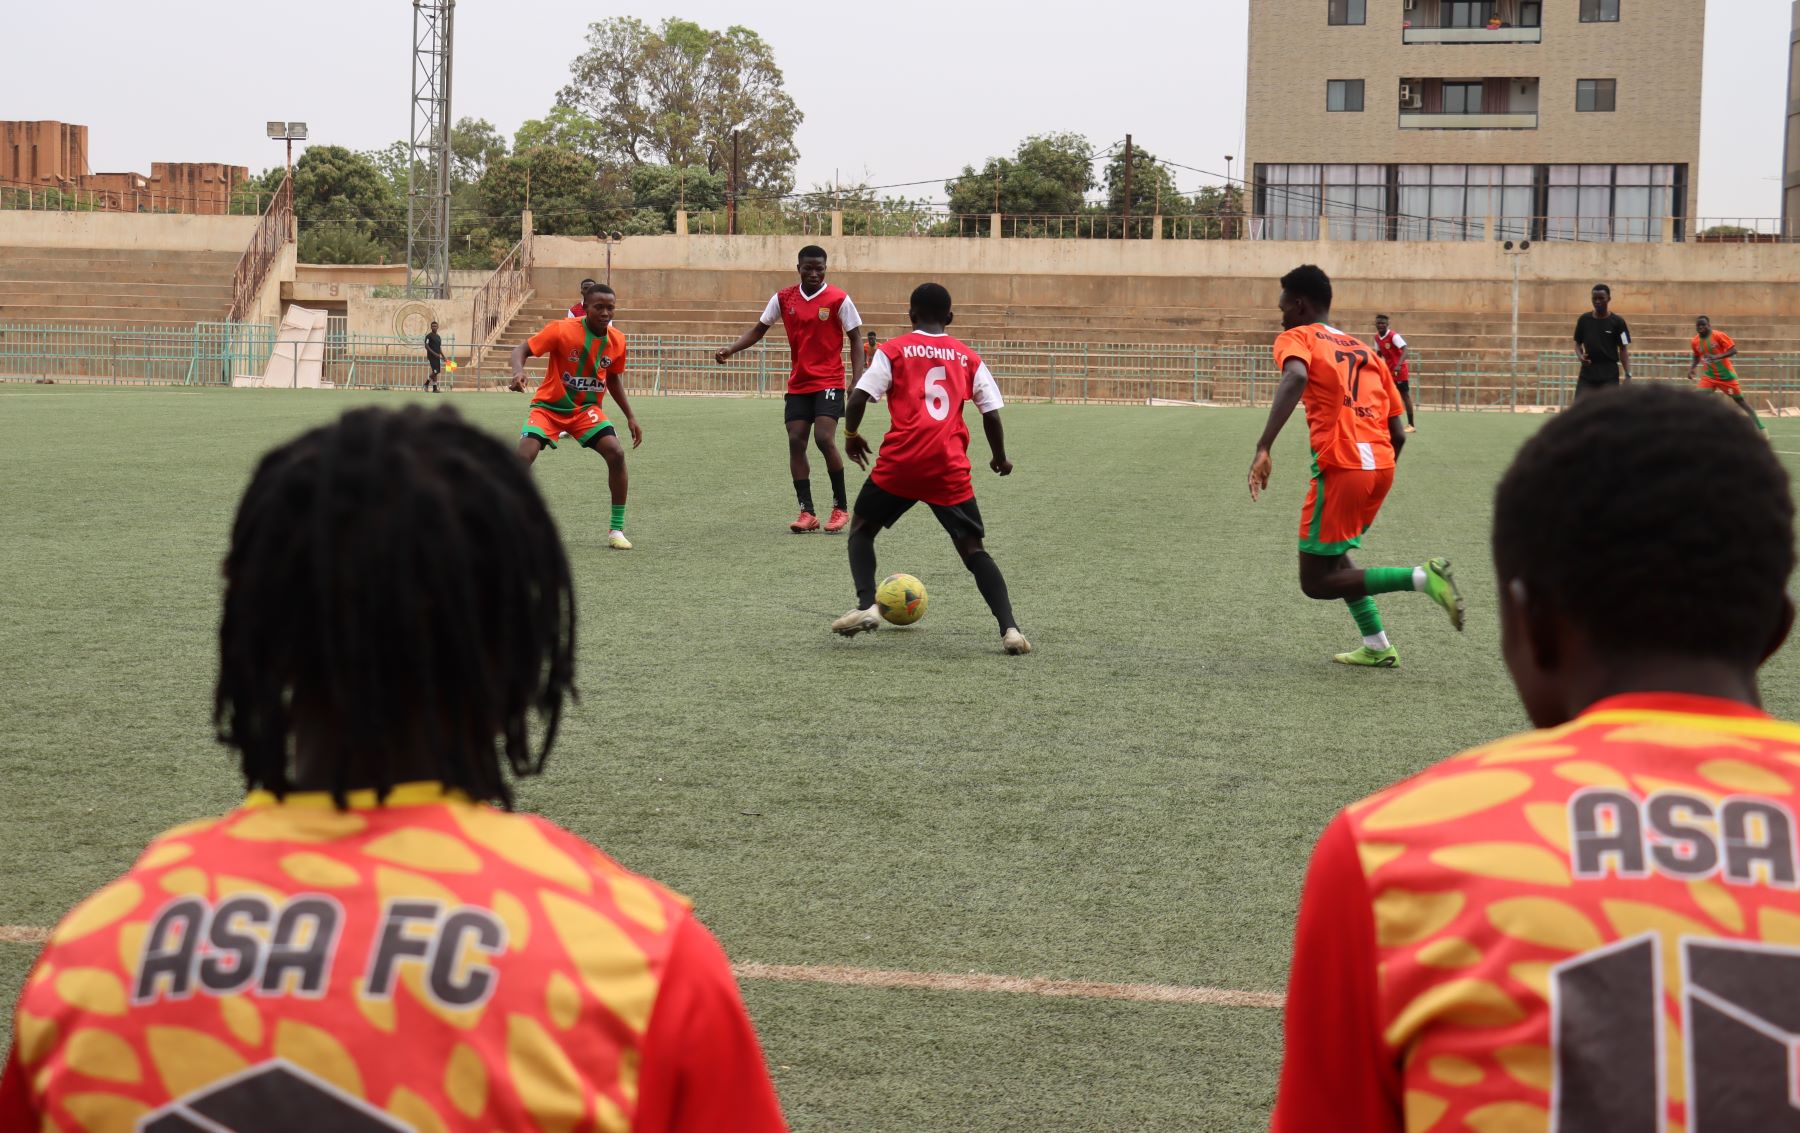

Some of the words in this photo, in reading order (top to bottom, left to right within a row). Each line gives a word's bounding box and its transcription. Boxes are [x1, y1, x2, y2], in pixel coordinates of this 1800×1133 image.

[903, 345, 955, 361] KIOGHIN
[587, 409, 599, 423] 5
[925, 366, 949, 421] 6
[1568, 785, 1800, 888] ASA
[134, 893, 344, 1005] ASA
[363, 894, 505, 1011] FC
